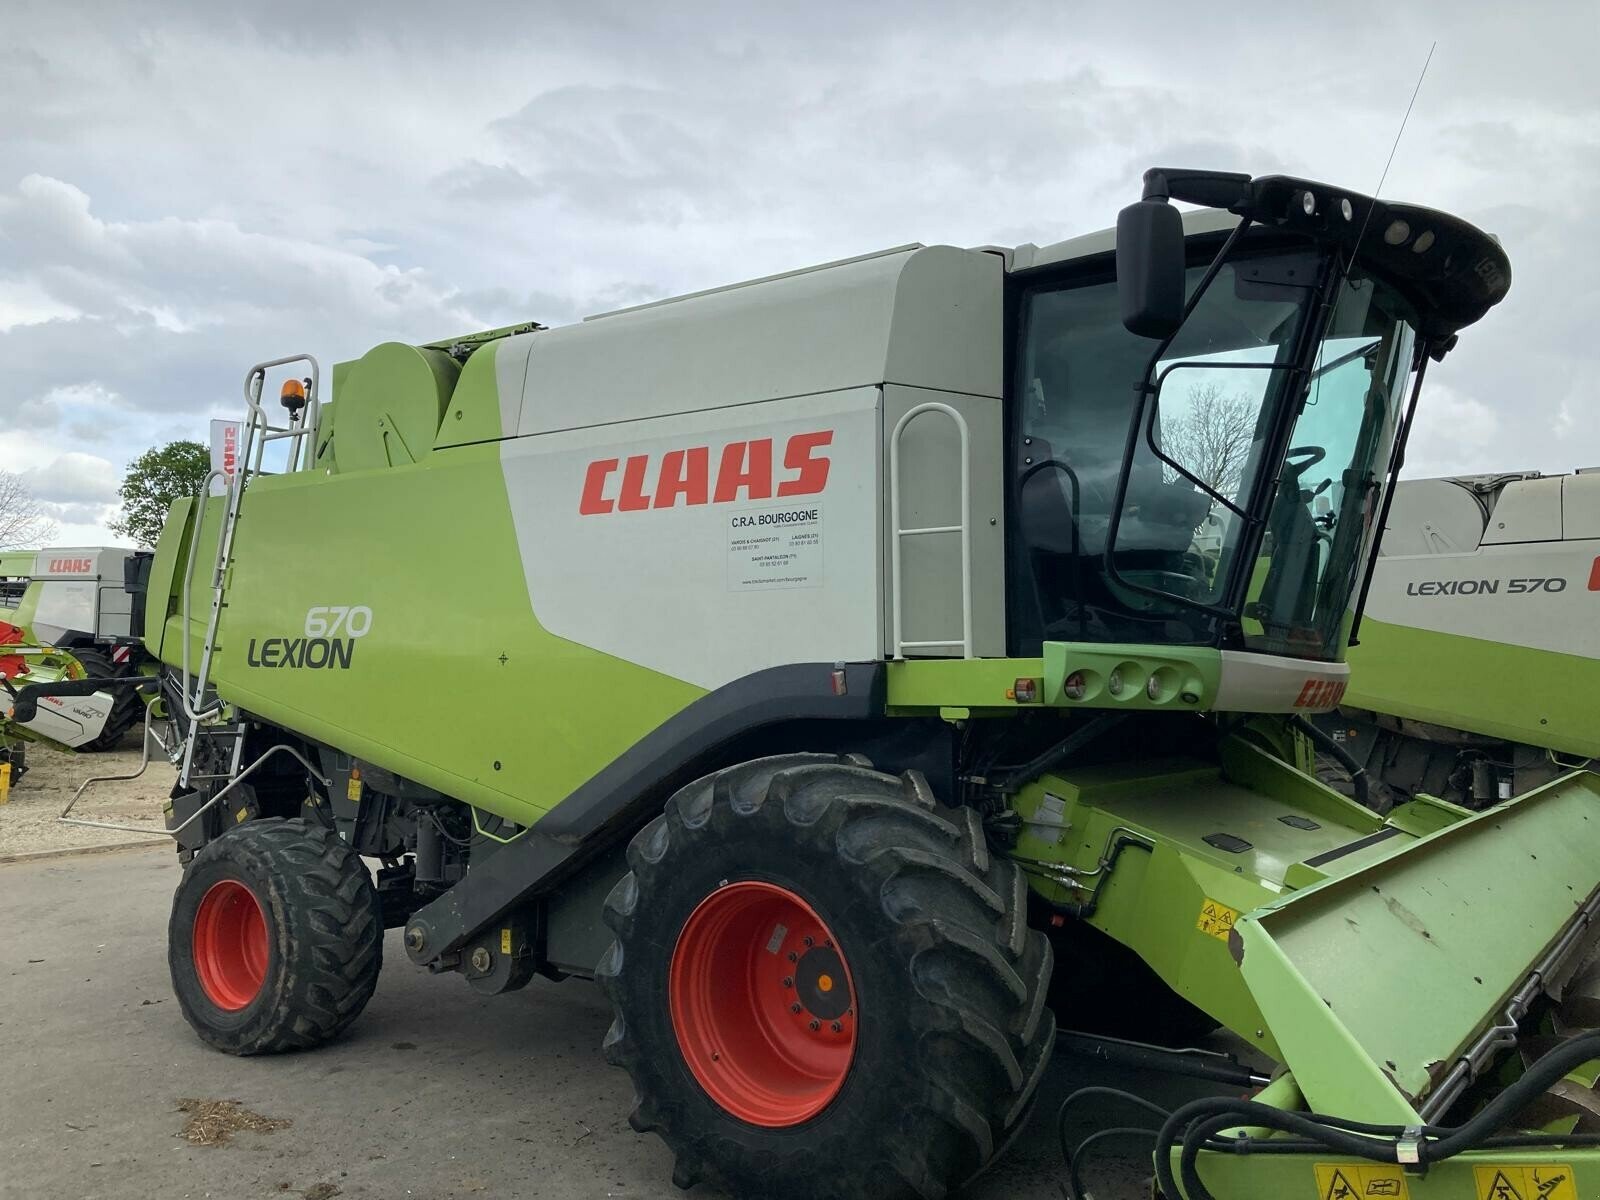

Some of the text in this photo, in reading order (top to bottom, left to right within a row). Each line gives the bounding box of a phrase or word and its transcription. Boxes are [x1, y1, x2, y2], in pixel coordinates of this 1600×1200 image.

[579, 429, 834, 516] CLAAS
[731, 516, 757, 528] C.R.A.
[758, 509, 818, 525] BOURGOGNE
[48, 559, 92, 573] CLAAS
[1407, 577, 1567, 597] LEXION 570
[304, 605, 373, 638] 670
[247, 638, 355, 669] LEXION
